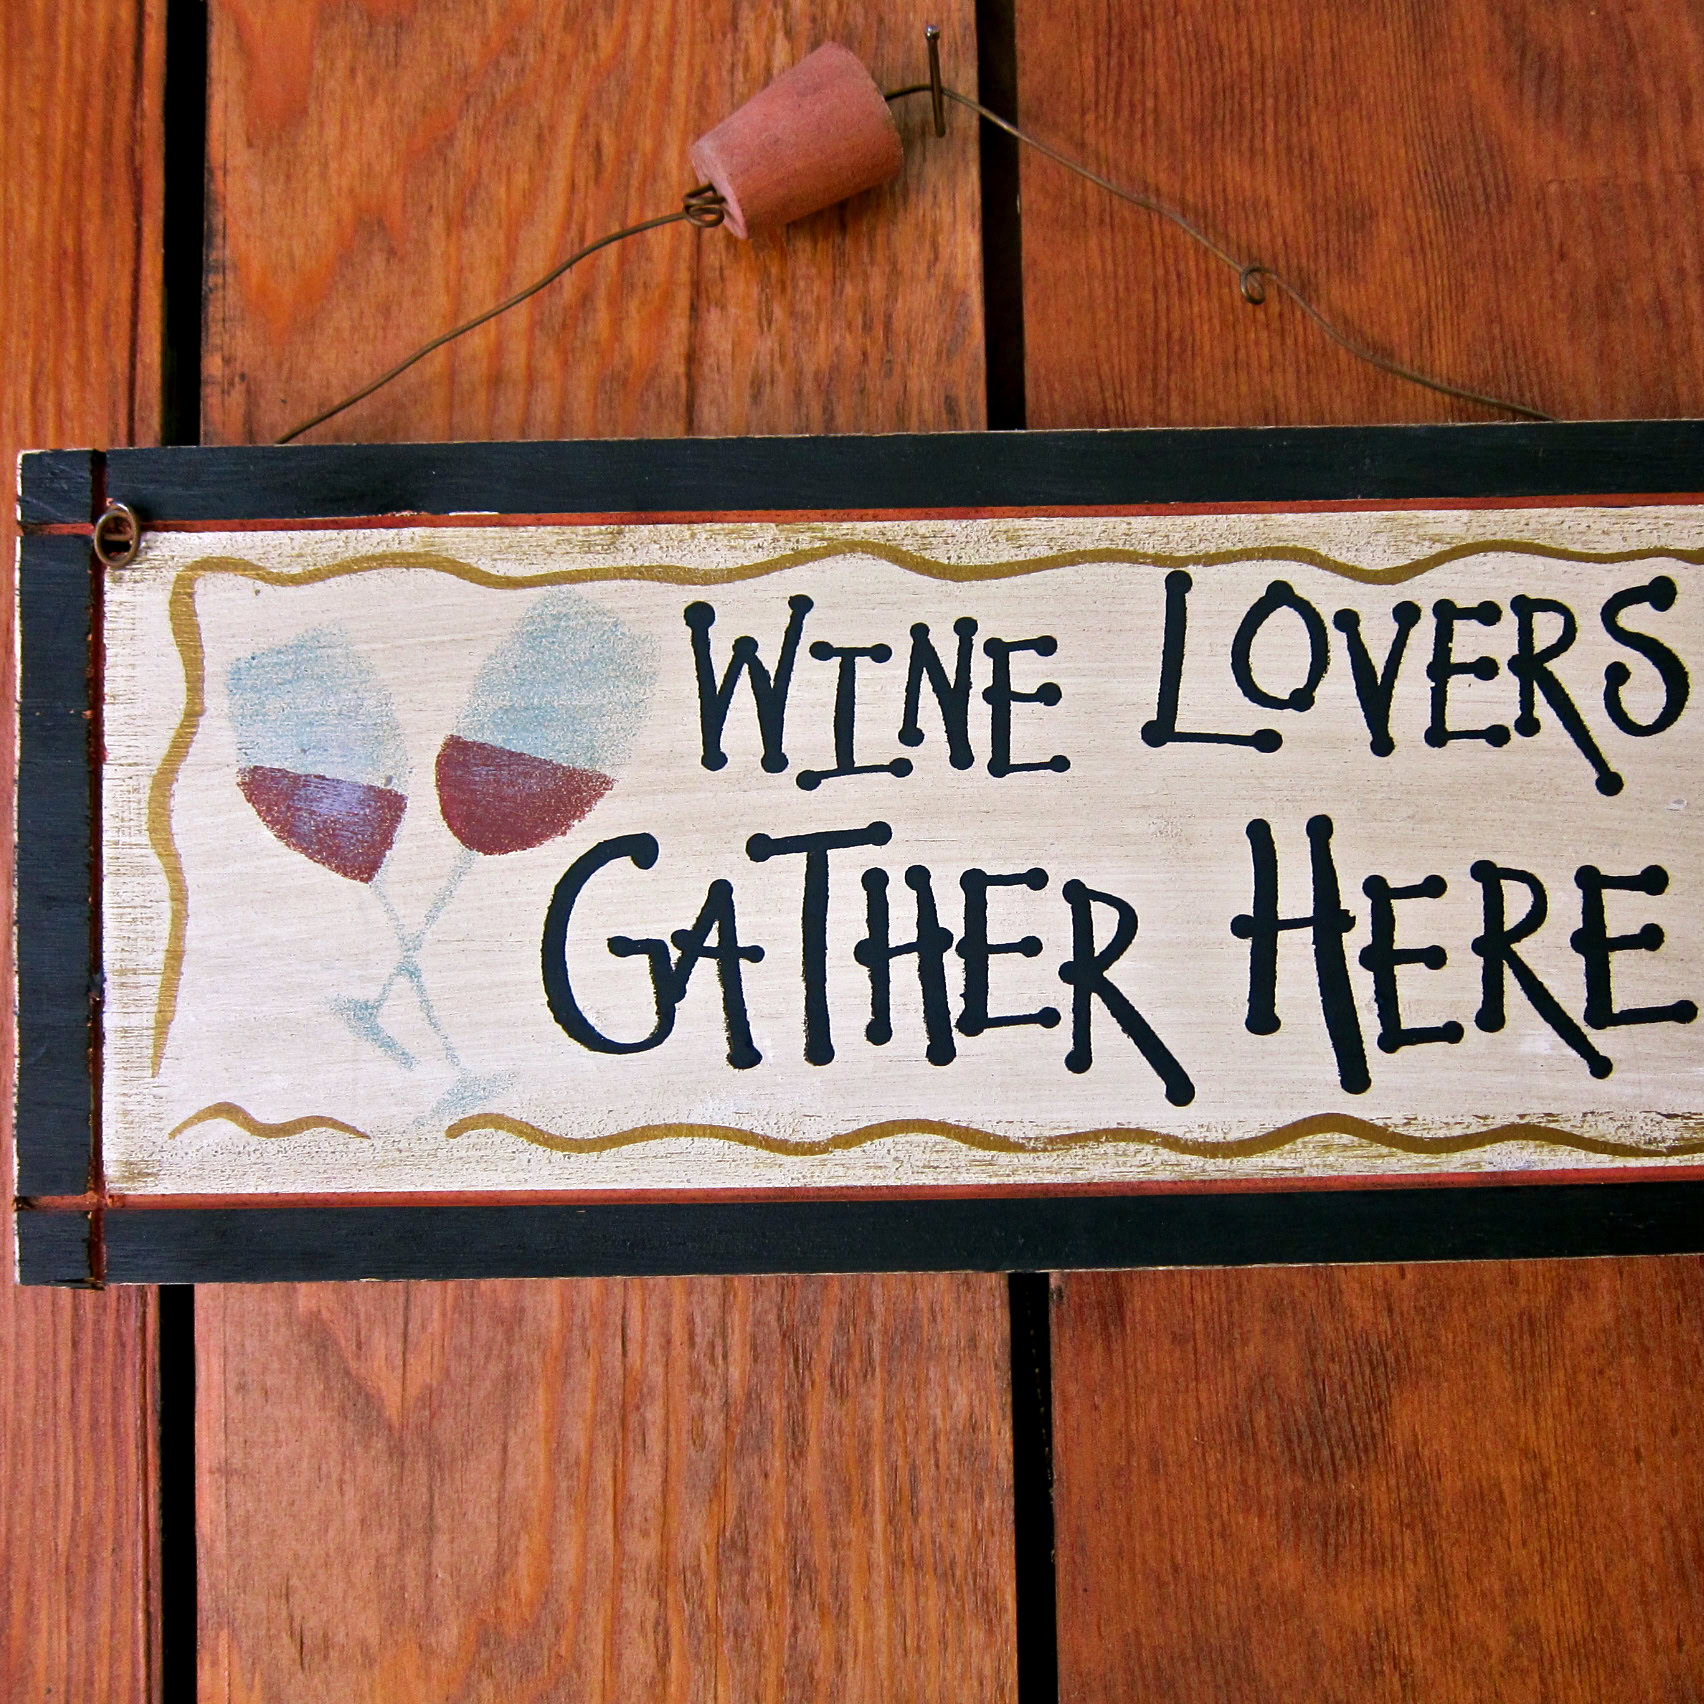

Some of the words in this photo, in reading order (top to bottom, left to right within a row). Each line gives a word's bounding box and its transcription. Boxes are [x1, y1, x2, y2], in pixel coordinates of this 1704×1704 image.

[684, 595, 1070, 791] WINE
[1141, 570, 1691, 797] LOVERS
[541, 821, 1195, 1107] GATHER
[1231, 814, 1699, 1095] HERE
